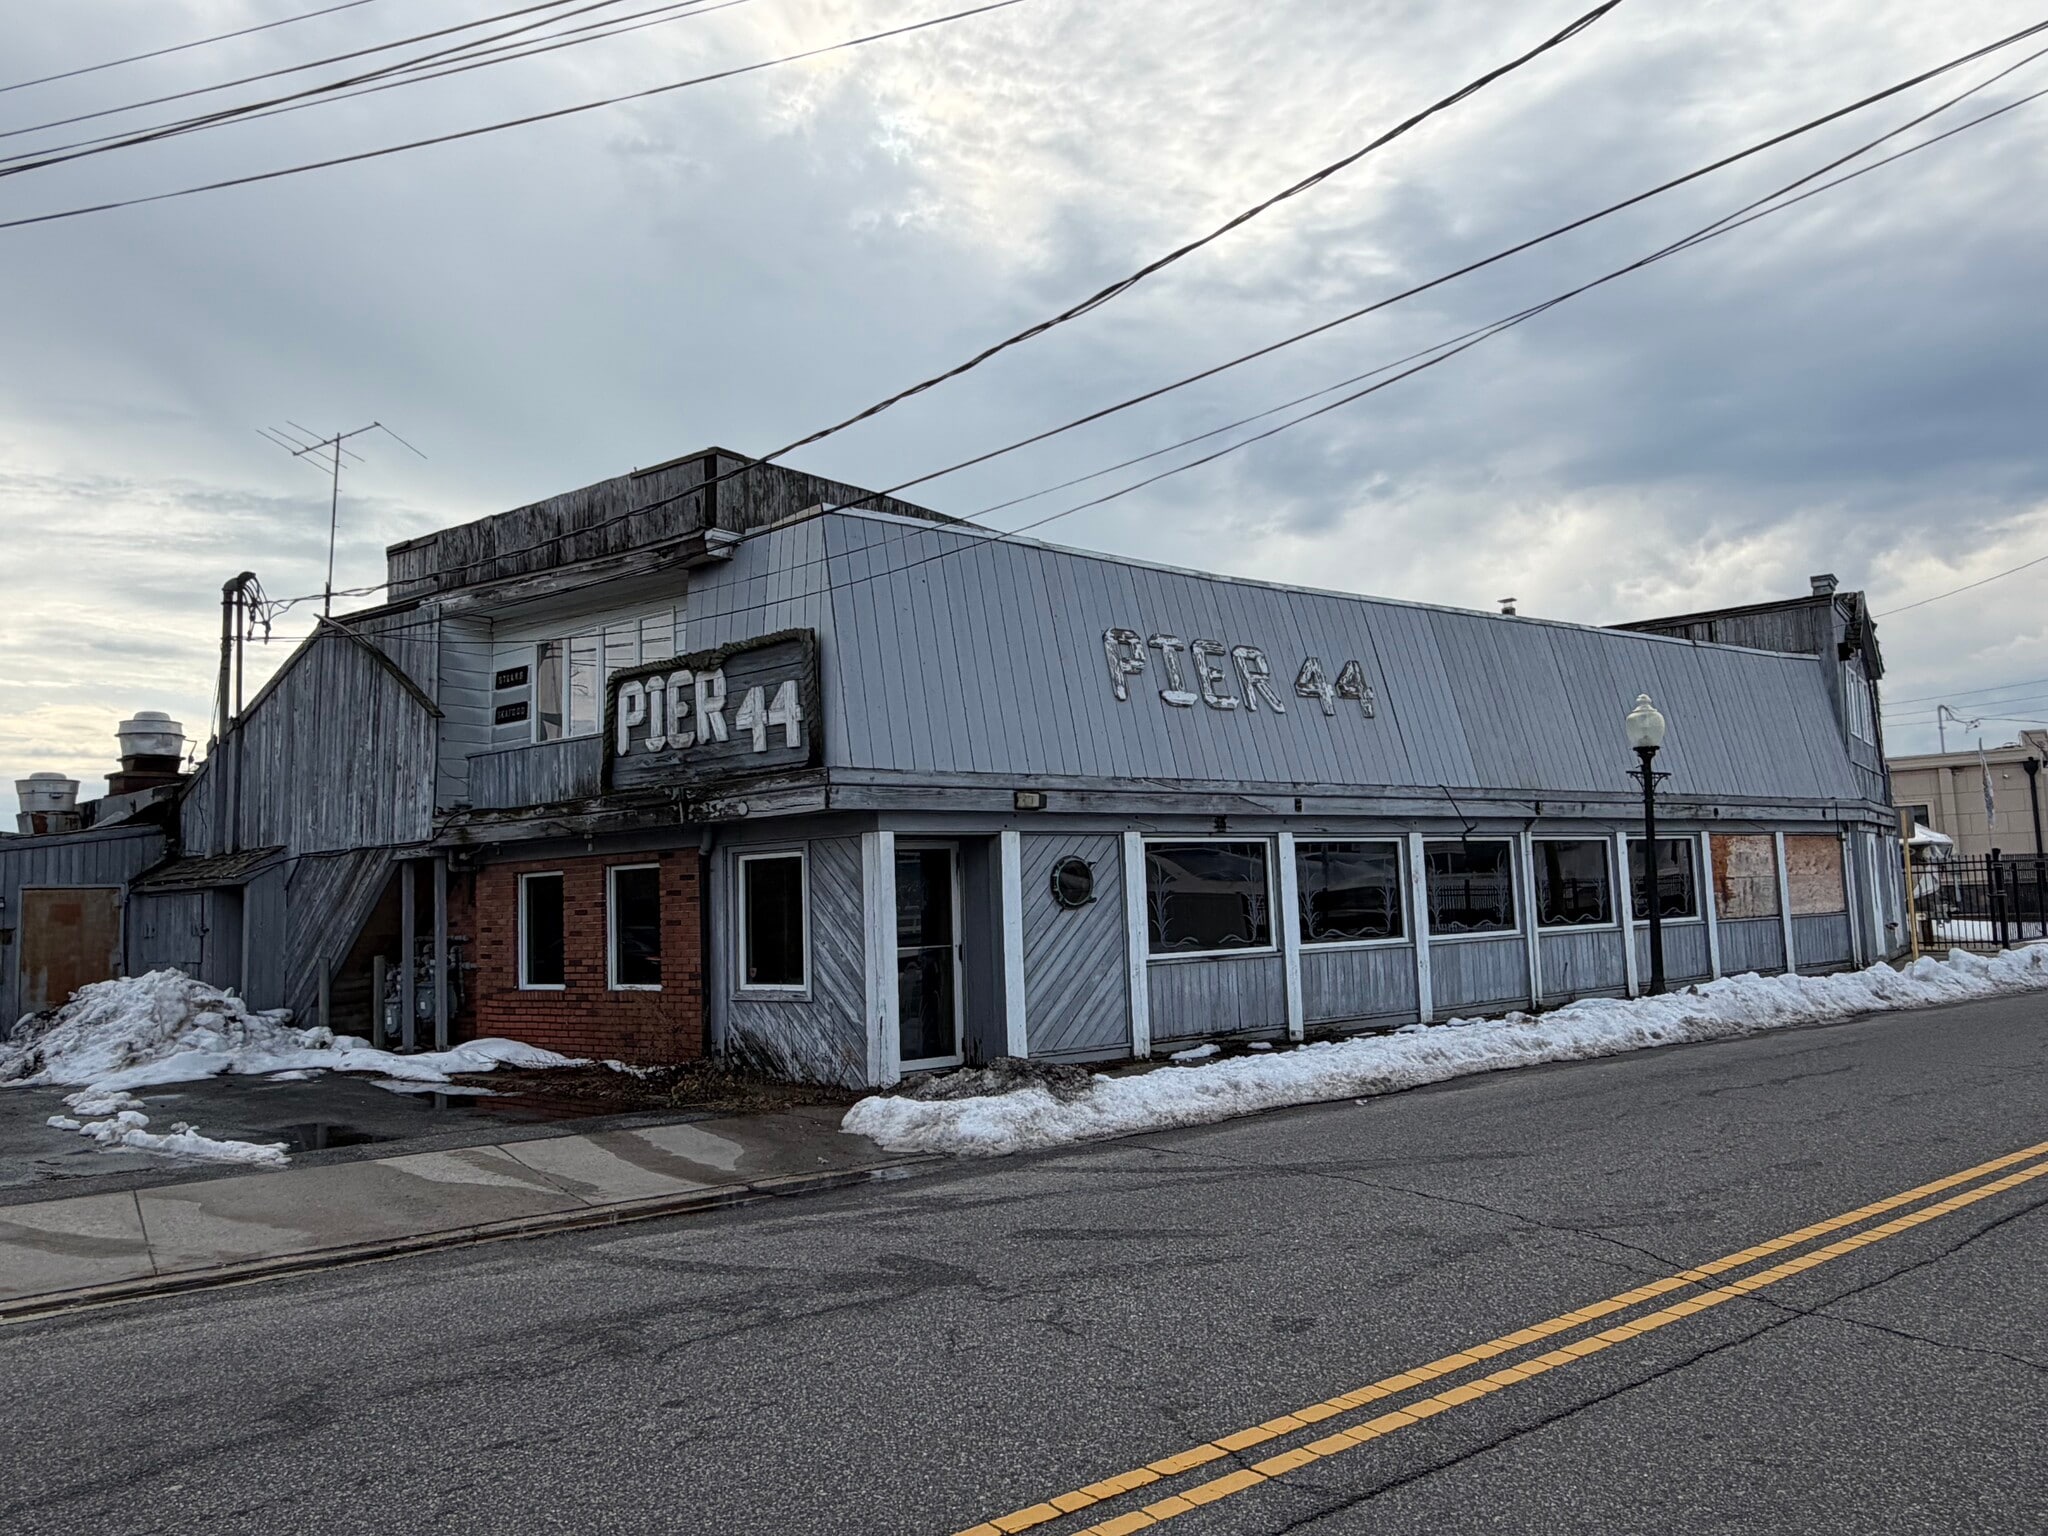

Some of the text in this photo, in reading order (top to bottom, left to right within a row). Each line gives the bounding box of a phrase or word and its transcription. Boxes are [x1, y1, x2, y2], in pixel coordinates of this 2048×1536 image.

[618, 668, 804, 756] PIER 44
[1102, 628, 1375, 719] PIER 44
